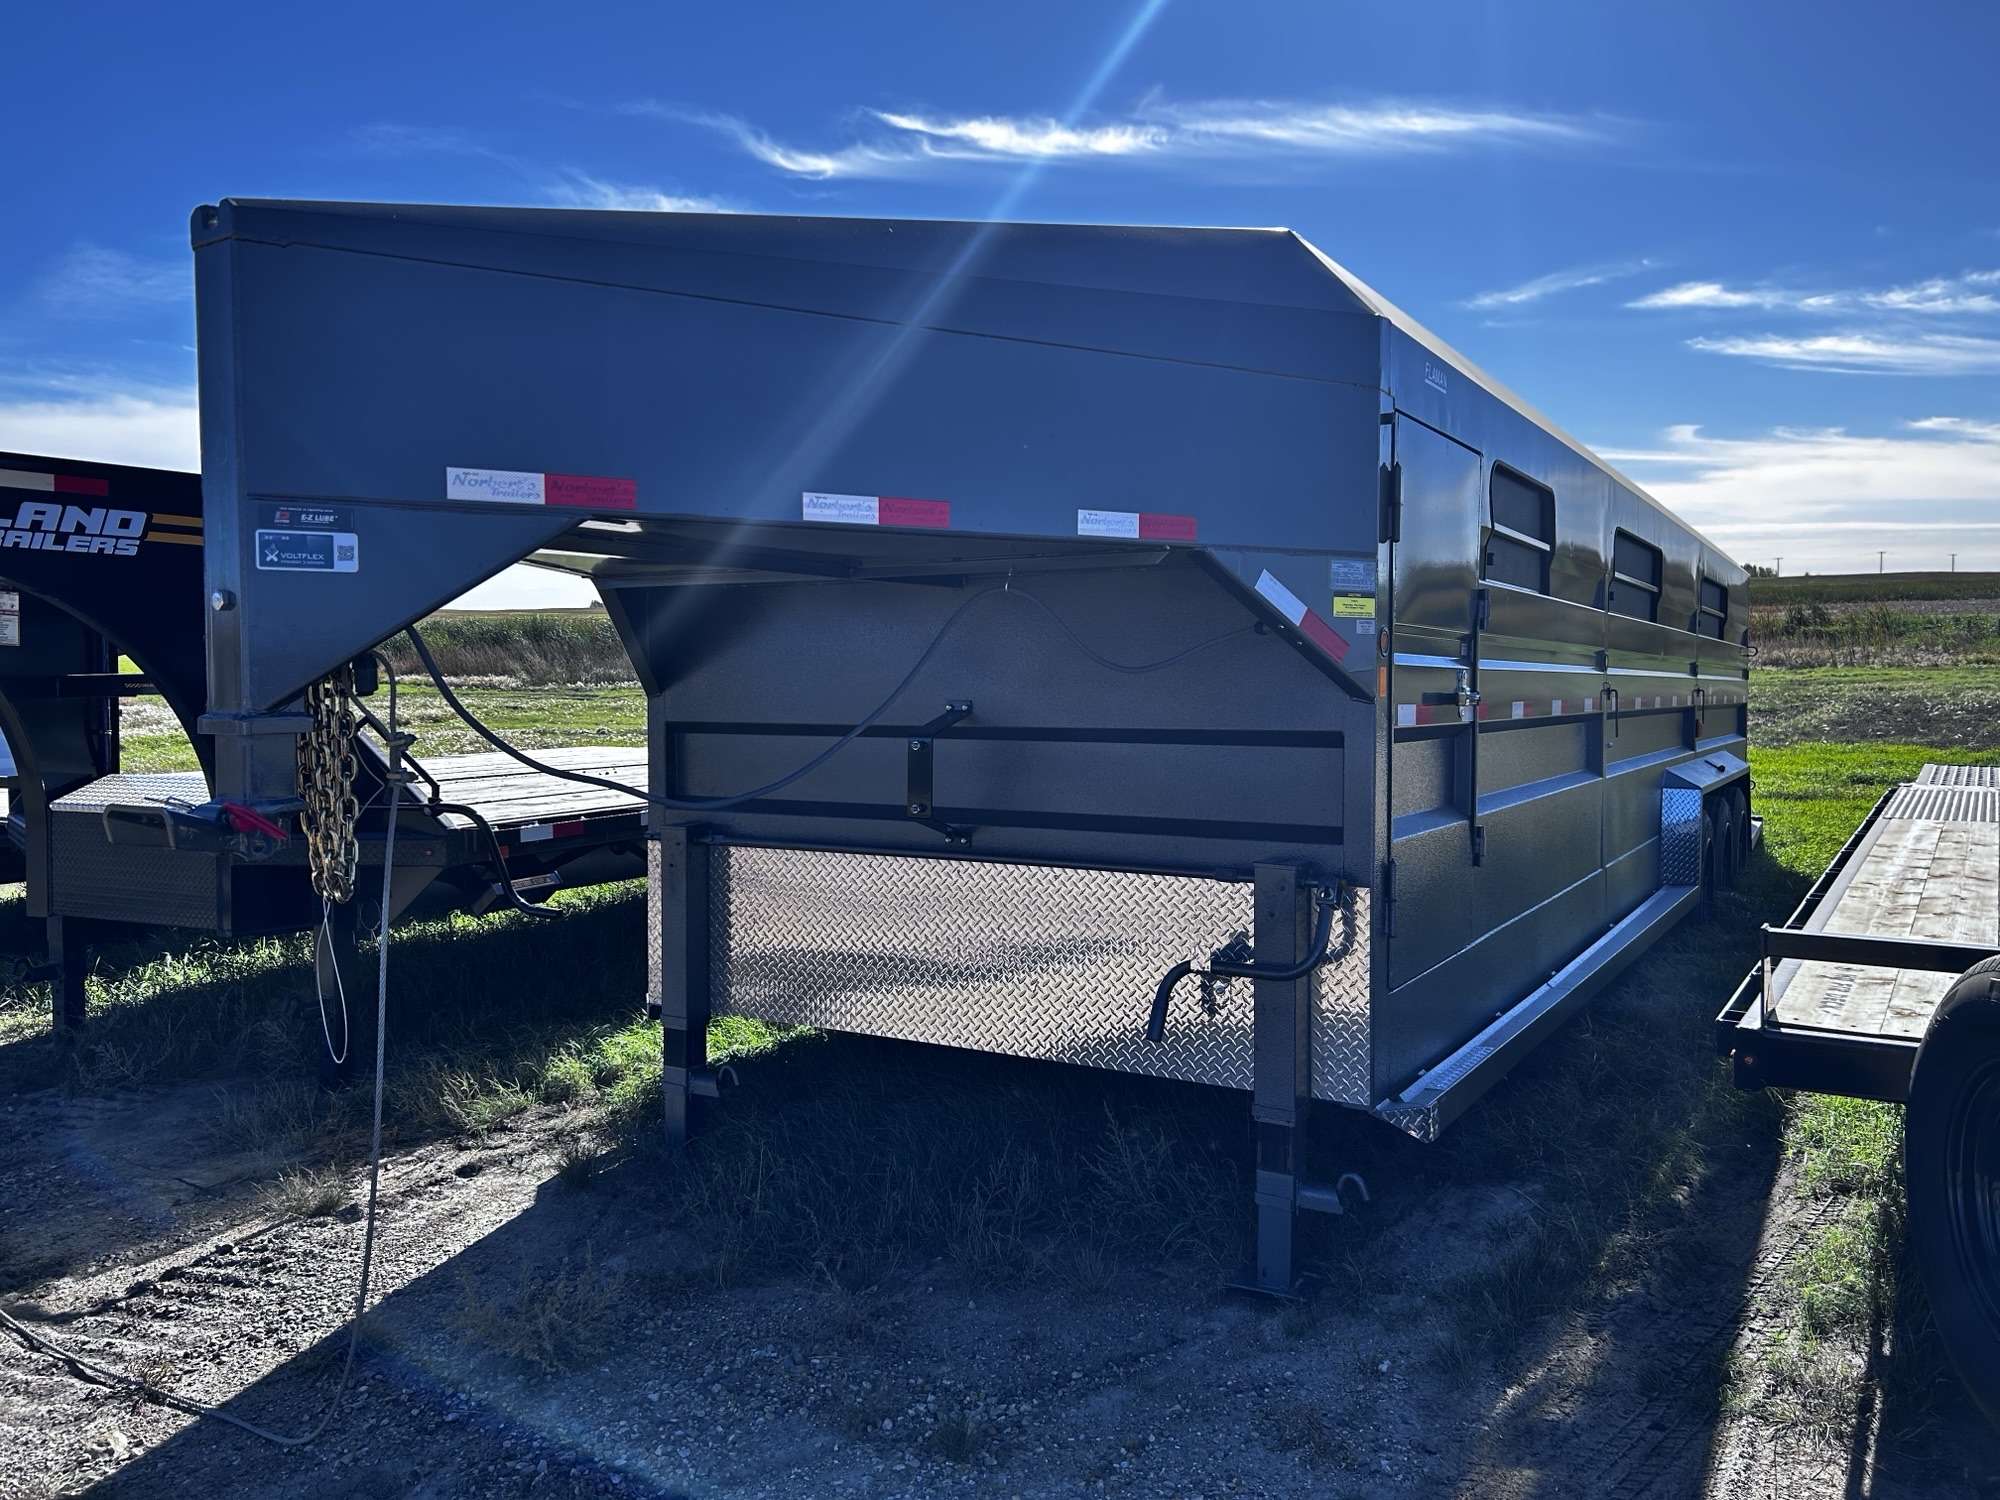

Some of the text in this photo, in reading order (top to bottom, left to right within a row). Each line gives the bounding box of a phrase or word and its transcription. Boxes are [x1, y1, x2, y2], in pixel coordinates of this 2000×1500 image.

[1425, 361, 1448, 388] FLAMAN
[452, 473, 537, 491] Norbert's
[491, 487, 541, 499] Trailers
[0, 501, 147, 538] AND
[280, 552, 325, 560] VOLTFLEX
